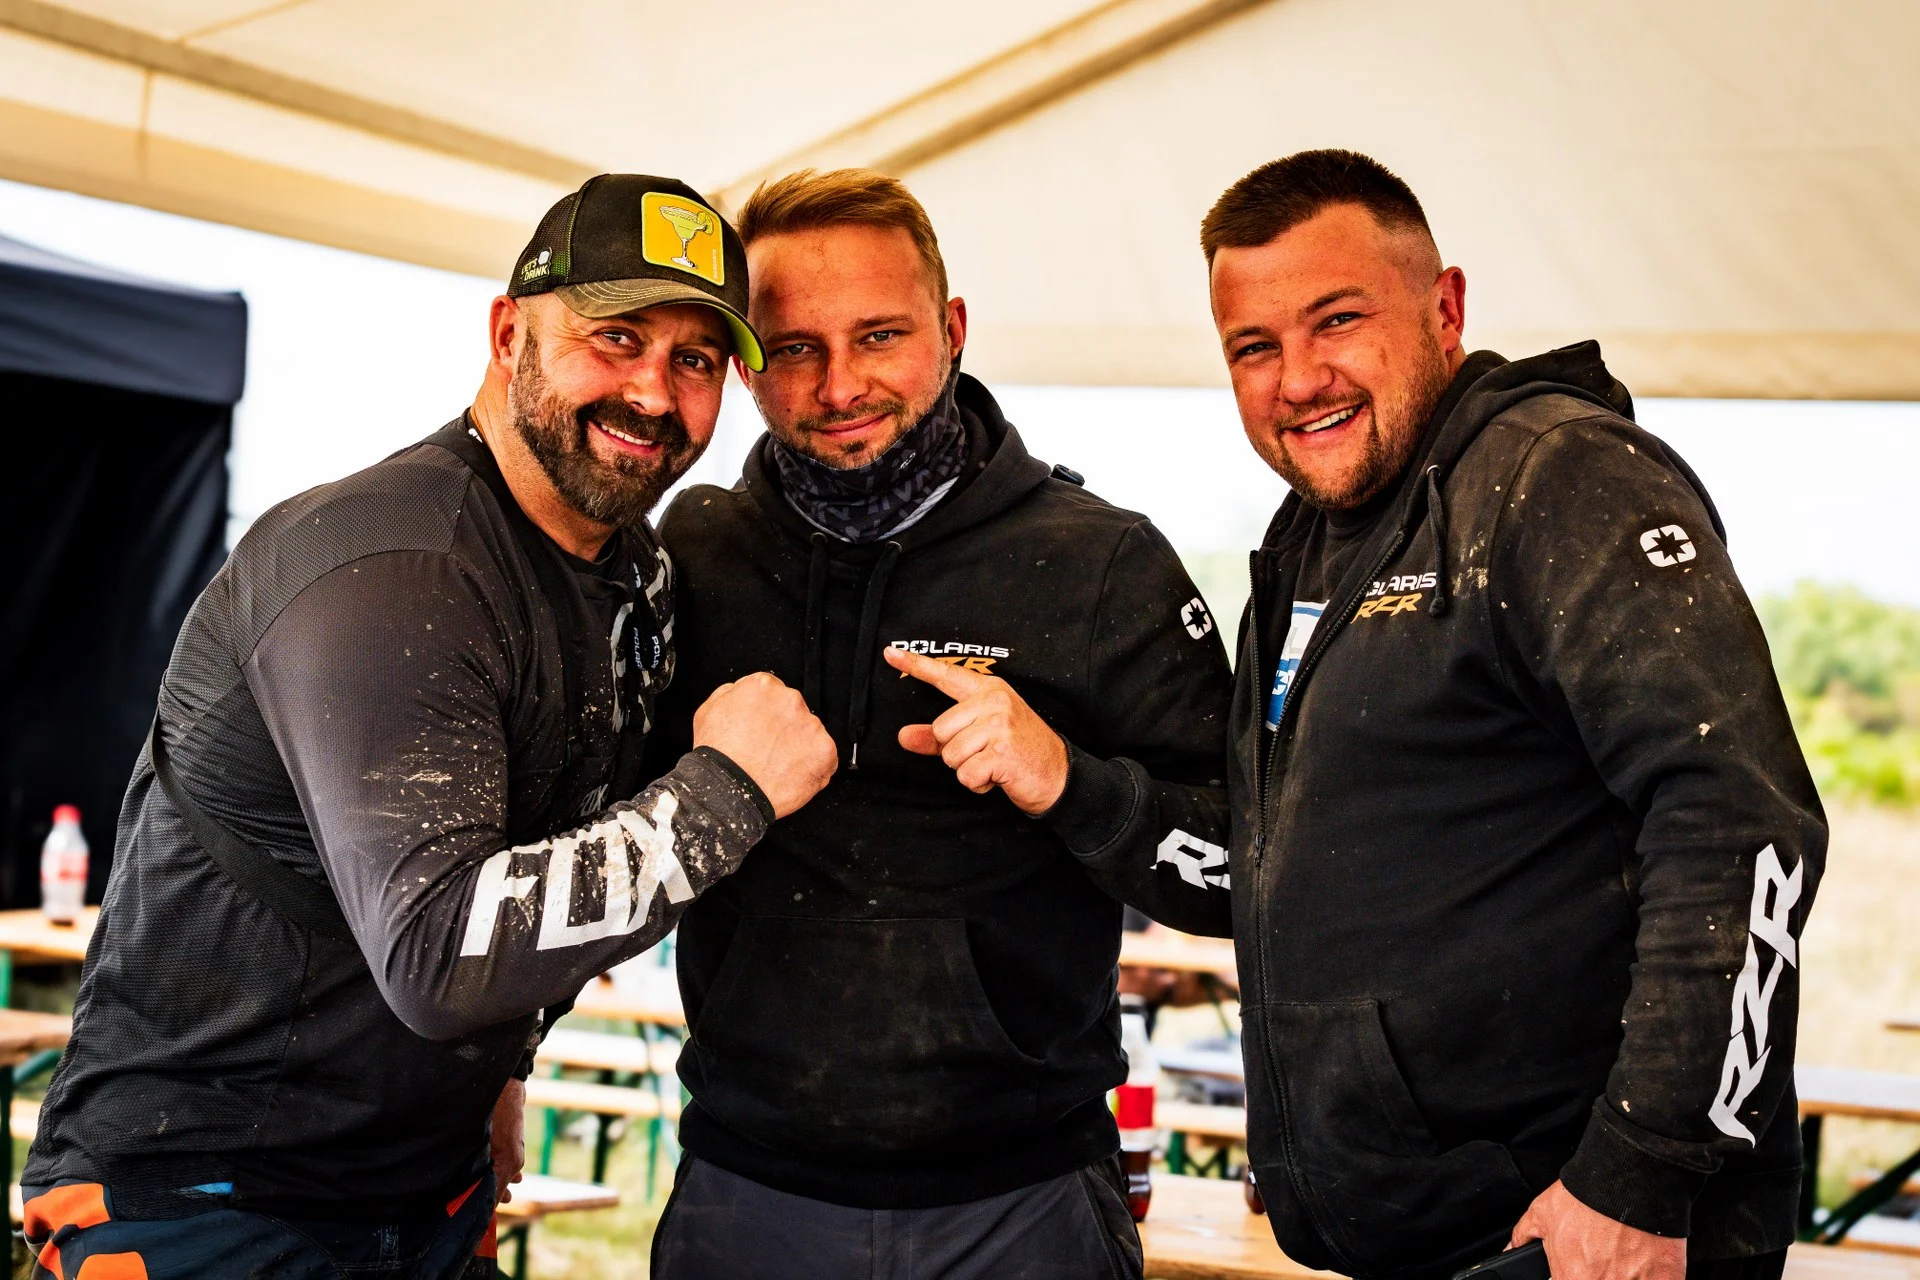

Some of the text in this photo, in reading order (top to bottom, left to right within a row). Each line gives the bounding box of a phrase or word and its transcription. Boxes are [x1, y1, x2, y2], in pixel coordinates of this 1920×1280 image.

[524, 265, 548, 281] DRINK
[1365, 572, 1437, 597] OLARIS
[1350, 593, 1423, 624] RZR
[633, 627, 644, 670] POLAR
[651, 635, 660, 669] POLA
[460, 790, 696, 957] FOX
[1707, 843, 1805, 1149] RZR
